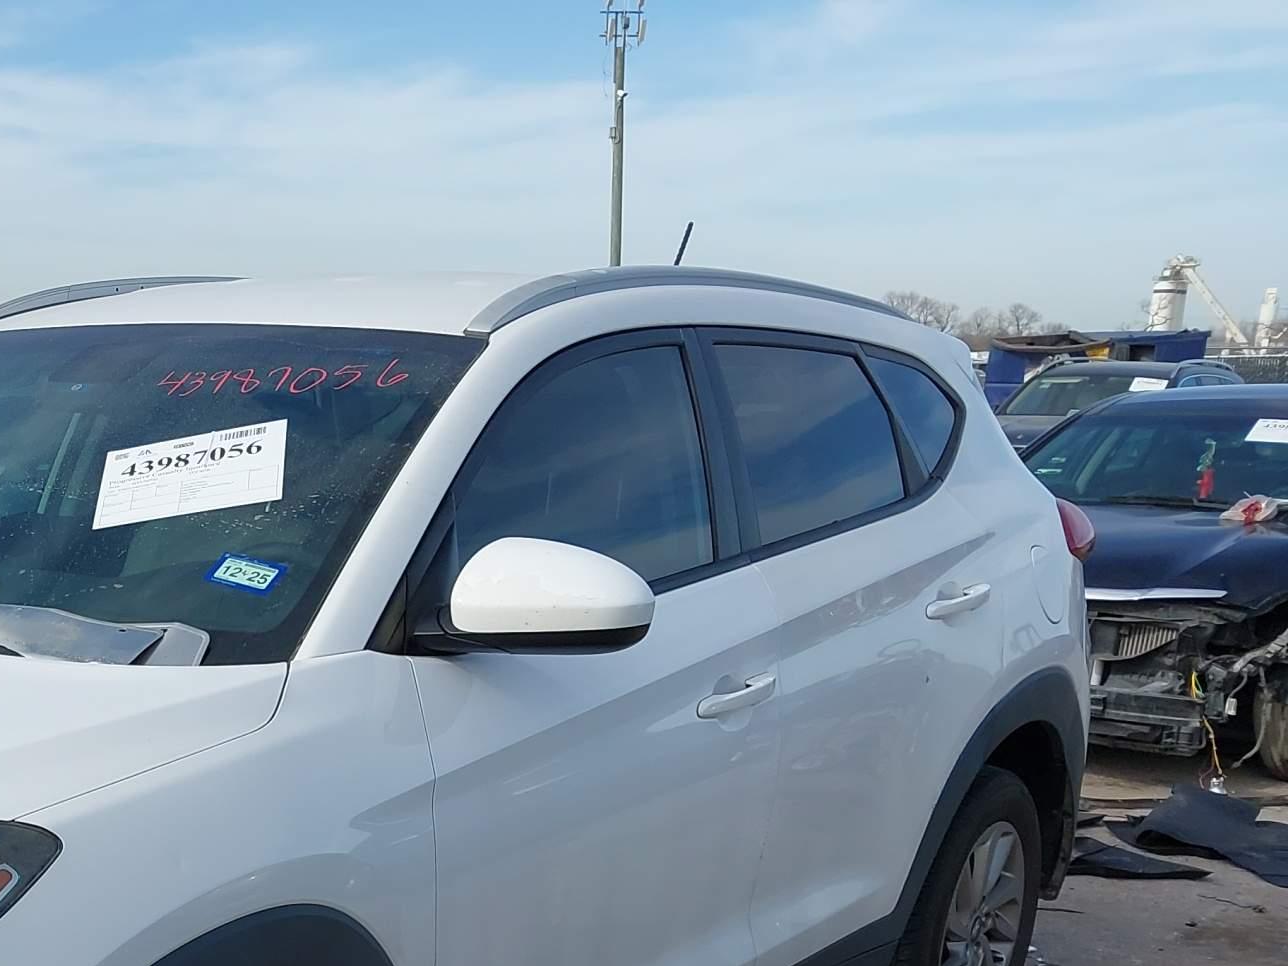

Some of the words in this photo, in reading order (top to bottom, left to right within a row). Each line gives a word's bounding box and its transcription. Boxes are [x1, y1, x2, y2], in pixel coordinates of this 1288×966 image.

[157, 358, 409, 397] 43987056
[120, 439, 264, 477] 43987056
[246, 571, 271, 585] 25
